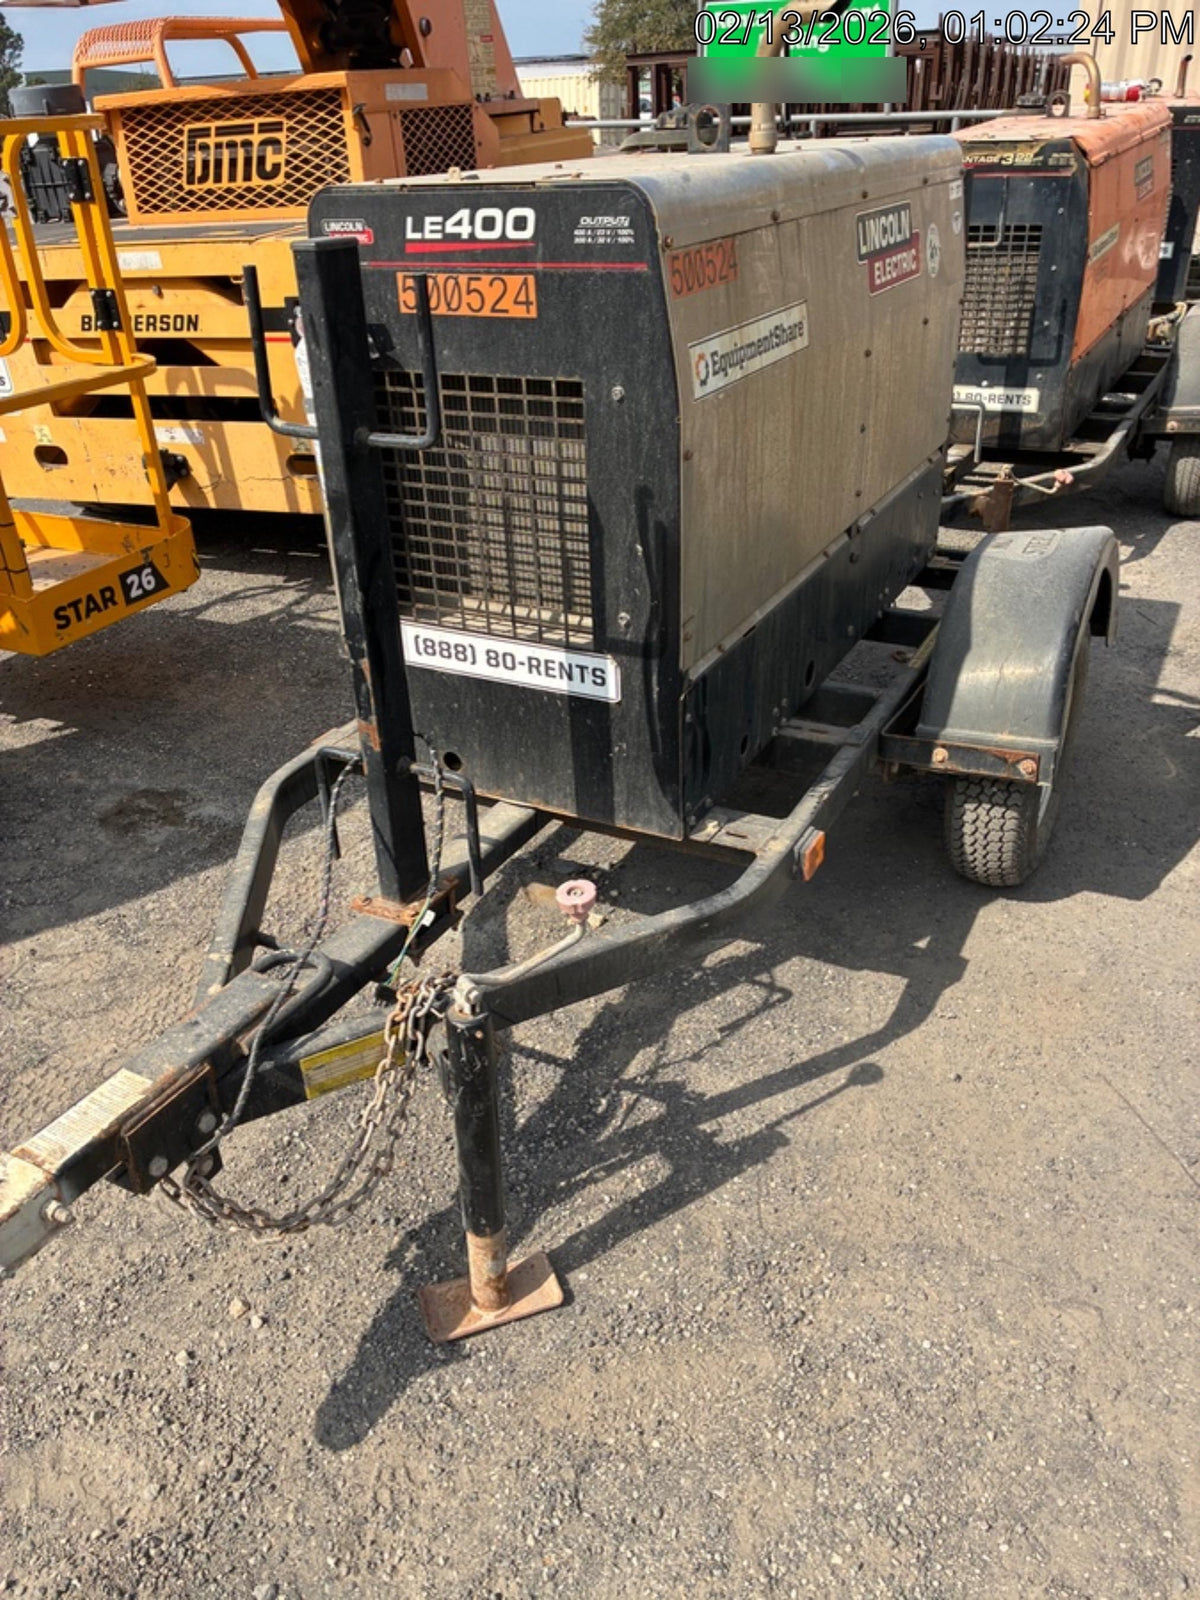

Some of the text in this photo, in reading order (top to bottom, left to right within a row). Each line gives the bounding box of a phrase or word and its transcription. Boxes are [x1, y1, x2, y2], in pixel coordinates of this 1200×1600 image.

[324, 221, 364, 232] LINCOLN
[405, 207, 536, 240] LE400
[858, 208, 910, 255] LINCOLN
[671, 242, 738, 295] 500524
[874, 248, 917, 286] ELECTRIC
[81, 314, 199, 332] BERSON
[710, 321, 804, 377] EquipmentShare
[53, 567, 156, 630] STAR 26
[413, 634, 606, 687] (888) 80-RENTS
